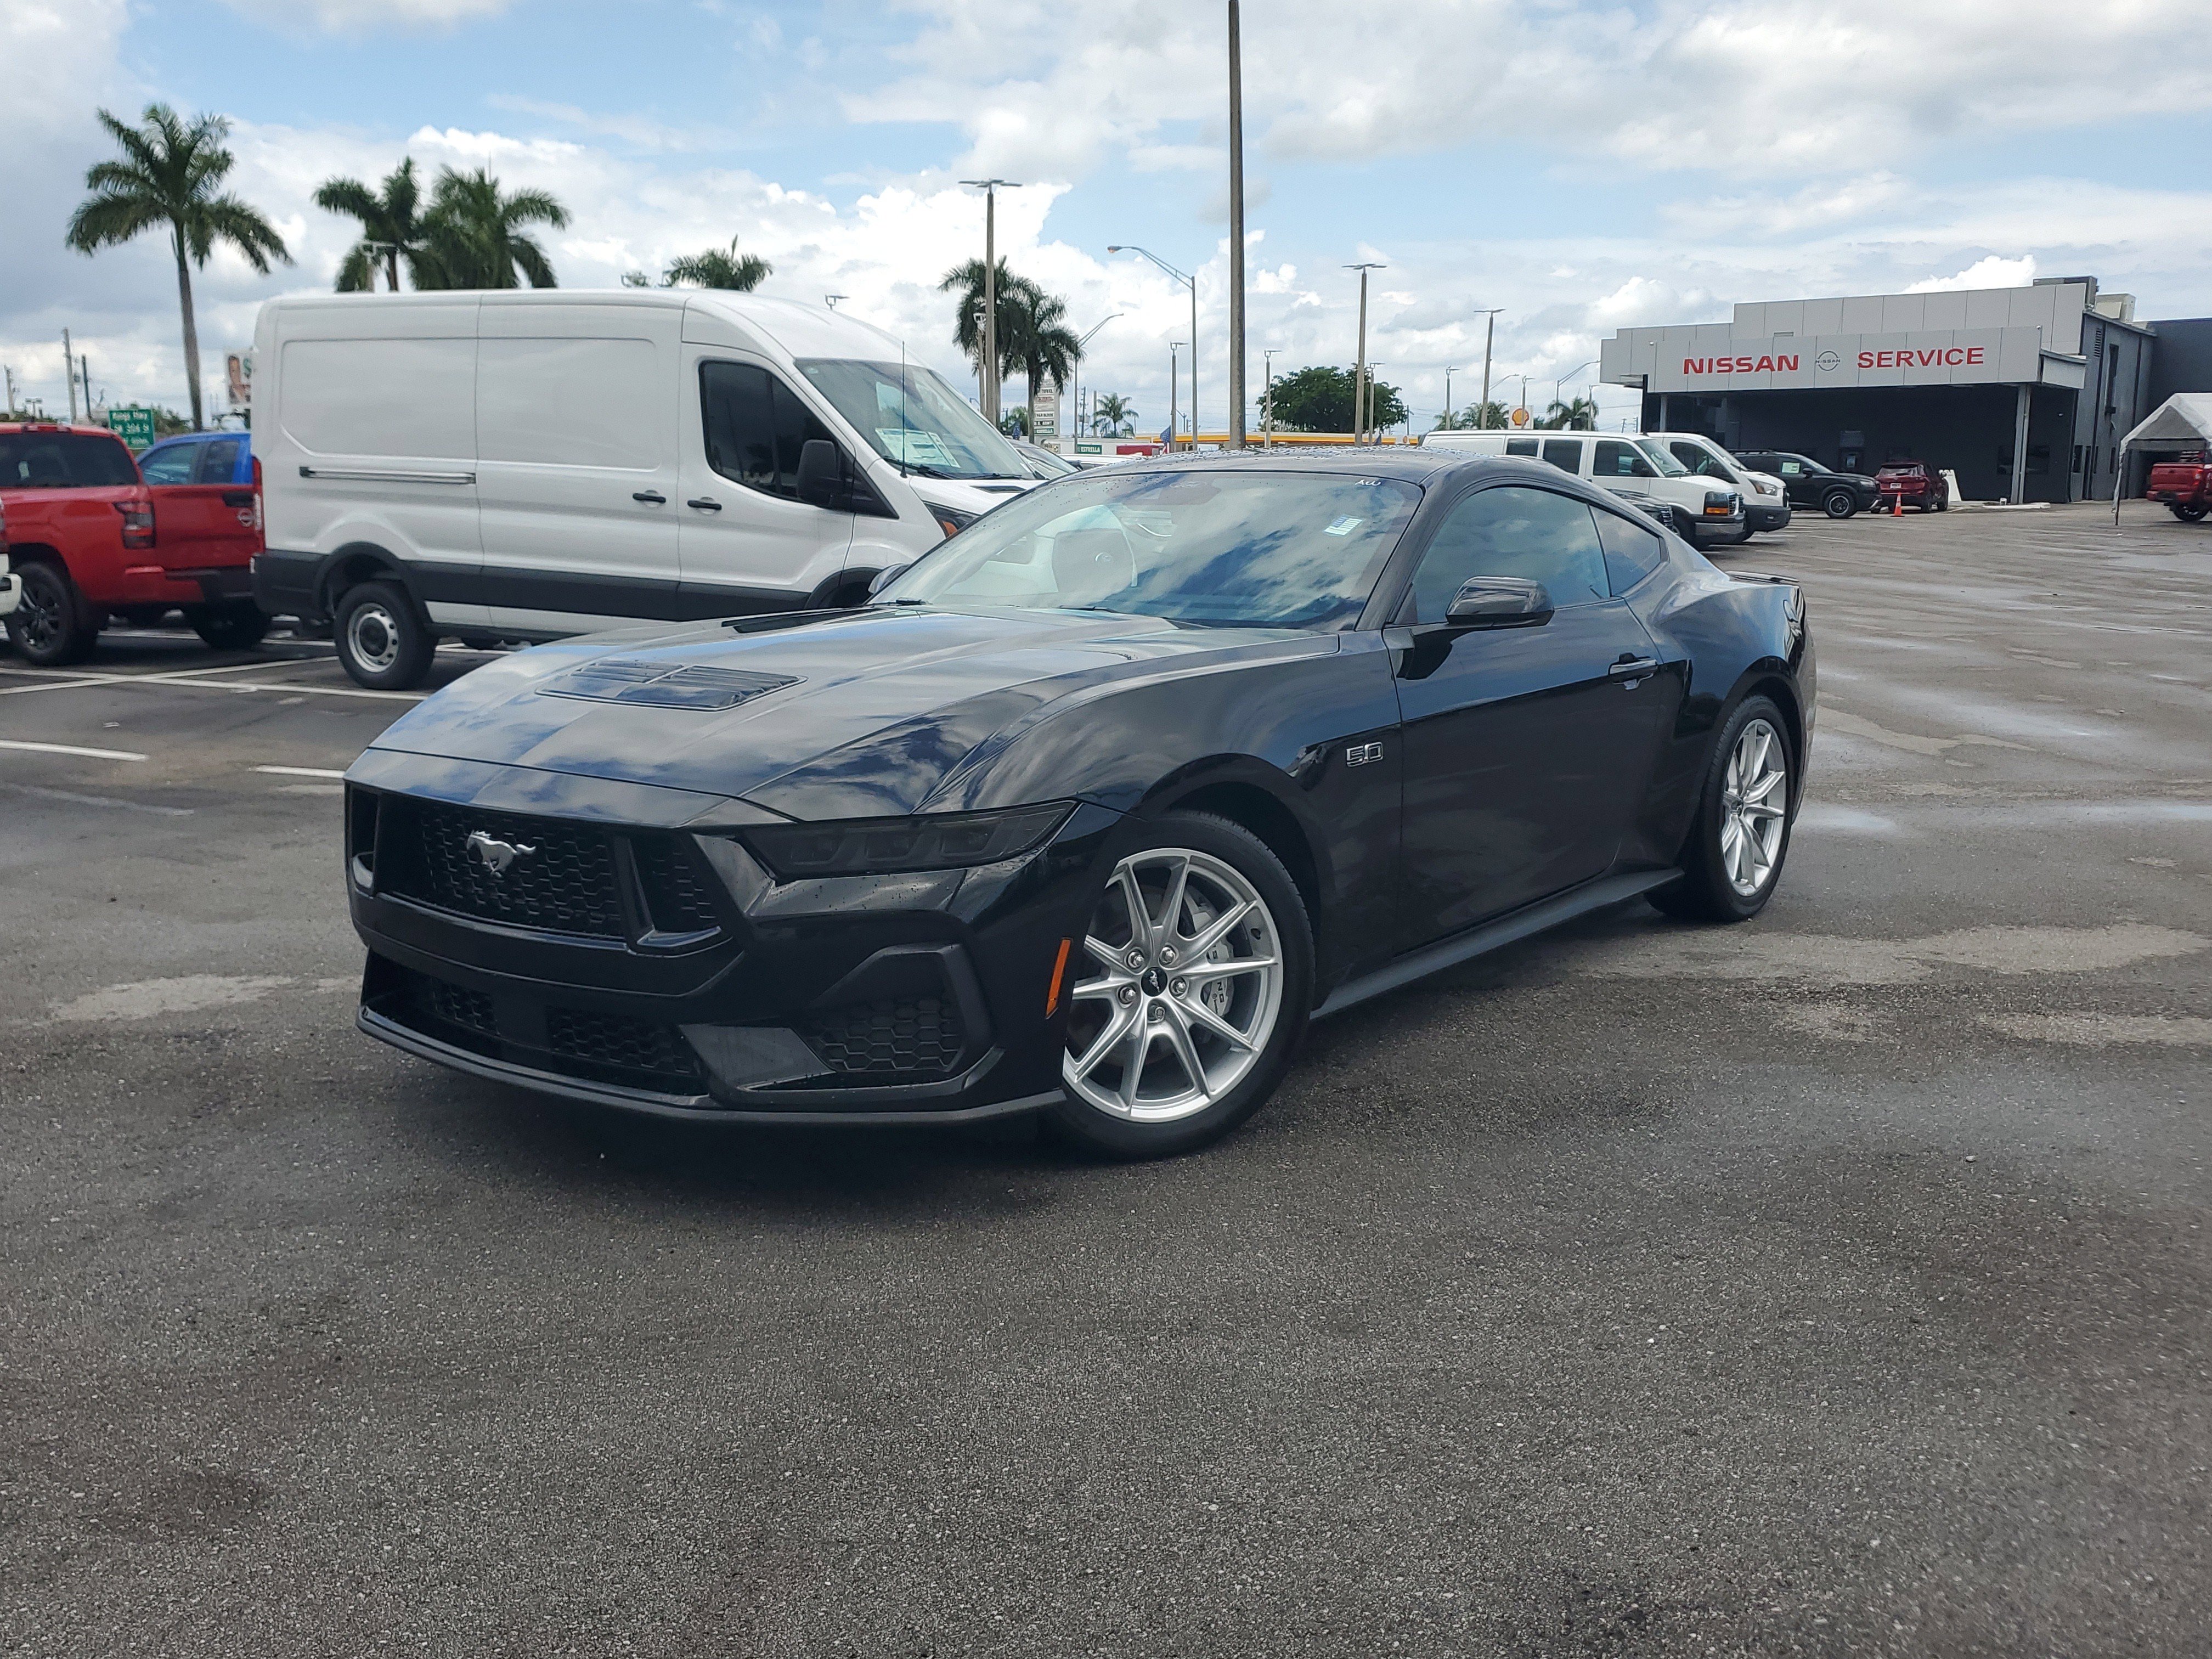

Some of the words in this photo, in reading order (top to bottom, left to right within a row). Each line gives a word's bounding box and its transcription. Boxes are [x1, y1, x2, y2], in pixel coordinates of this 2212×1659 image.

[1684, 355, 1799, 375] NISSAN
[1858, 347, 1984, 368] SERVICE
[1346, 742, 1383, 767] 5.0
